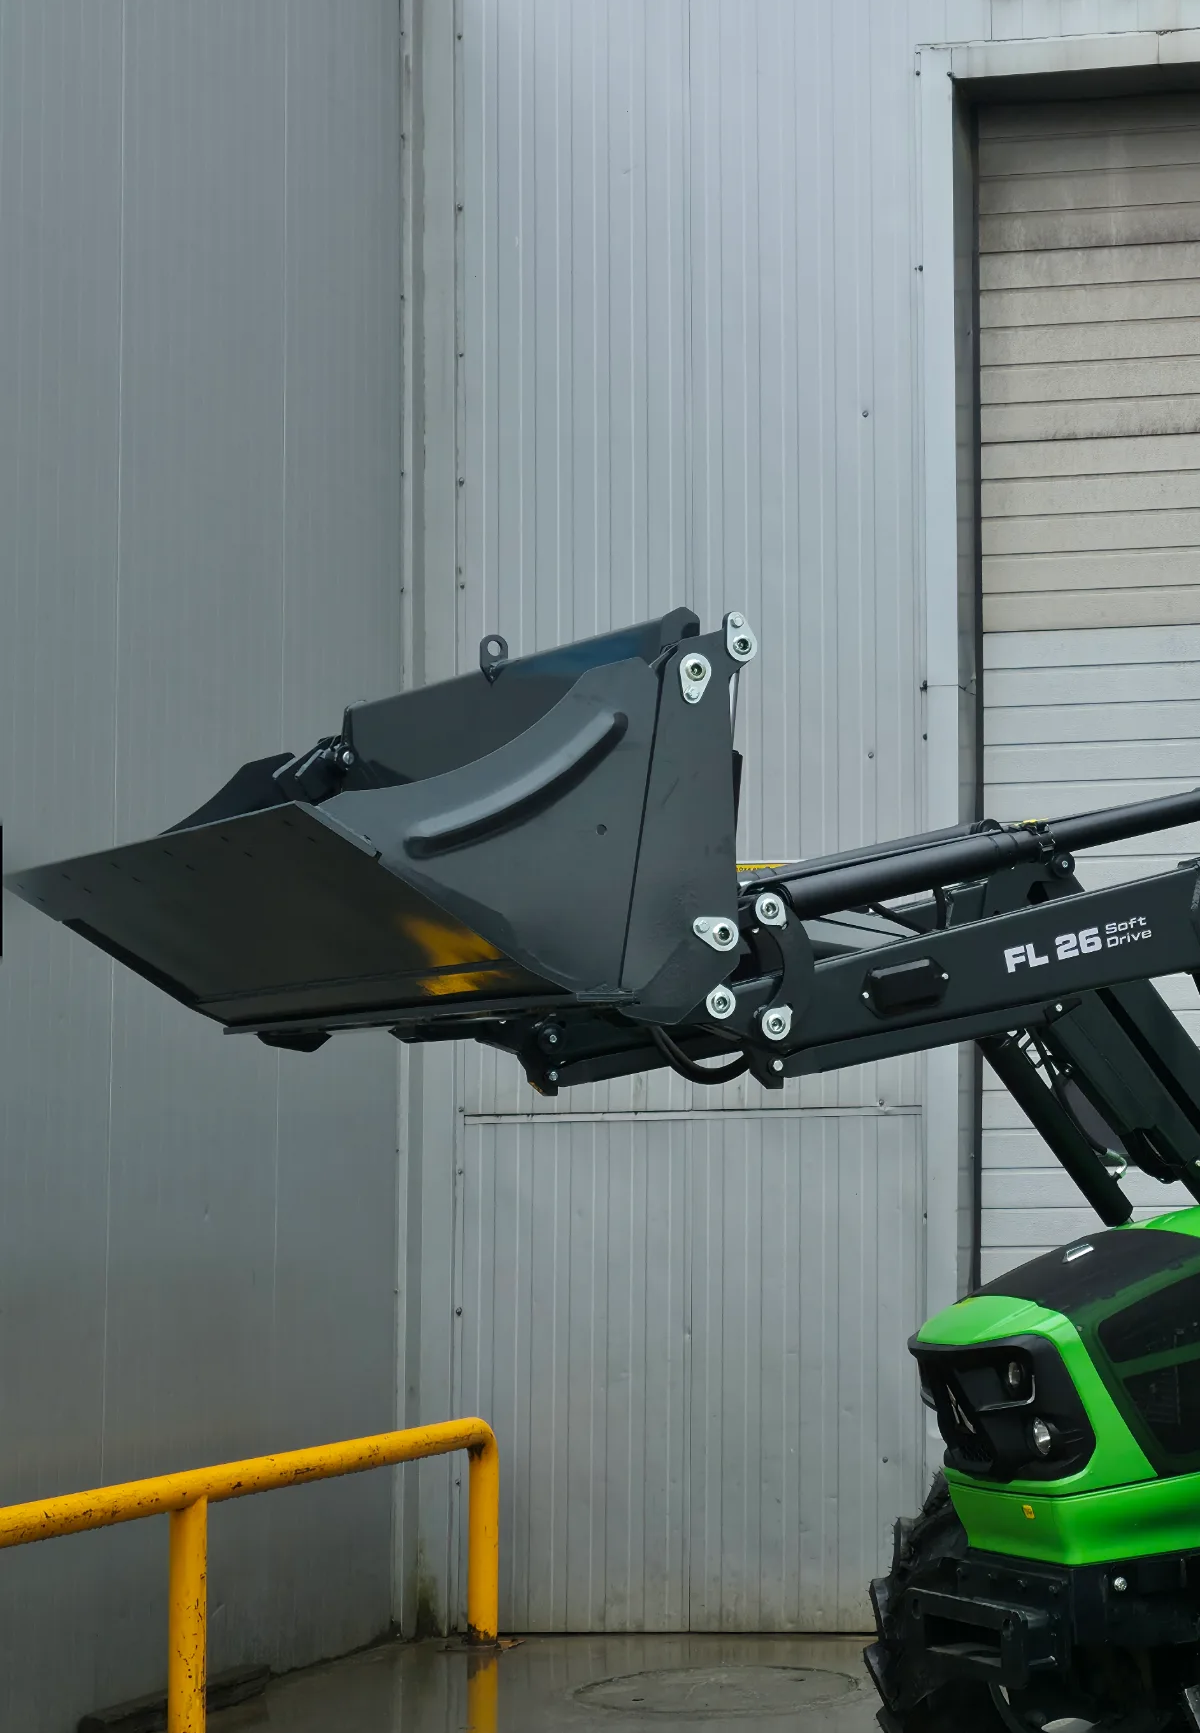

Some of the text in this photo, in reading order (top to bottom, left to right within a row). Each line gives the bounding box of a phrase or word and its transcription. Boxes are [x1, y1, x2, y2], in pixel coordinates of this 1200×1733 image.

[1105, 916, 1147, 934] Soft
[1107, 929, 1152, 948] Drive
[1004, 927, 1102, 973] FL 26
